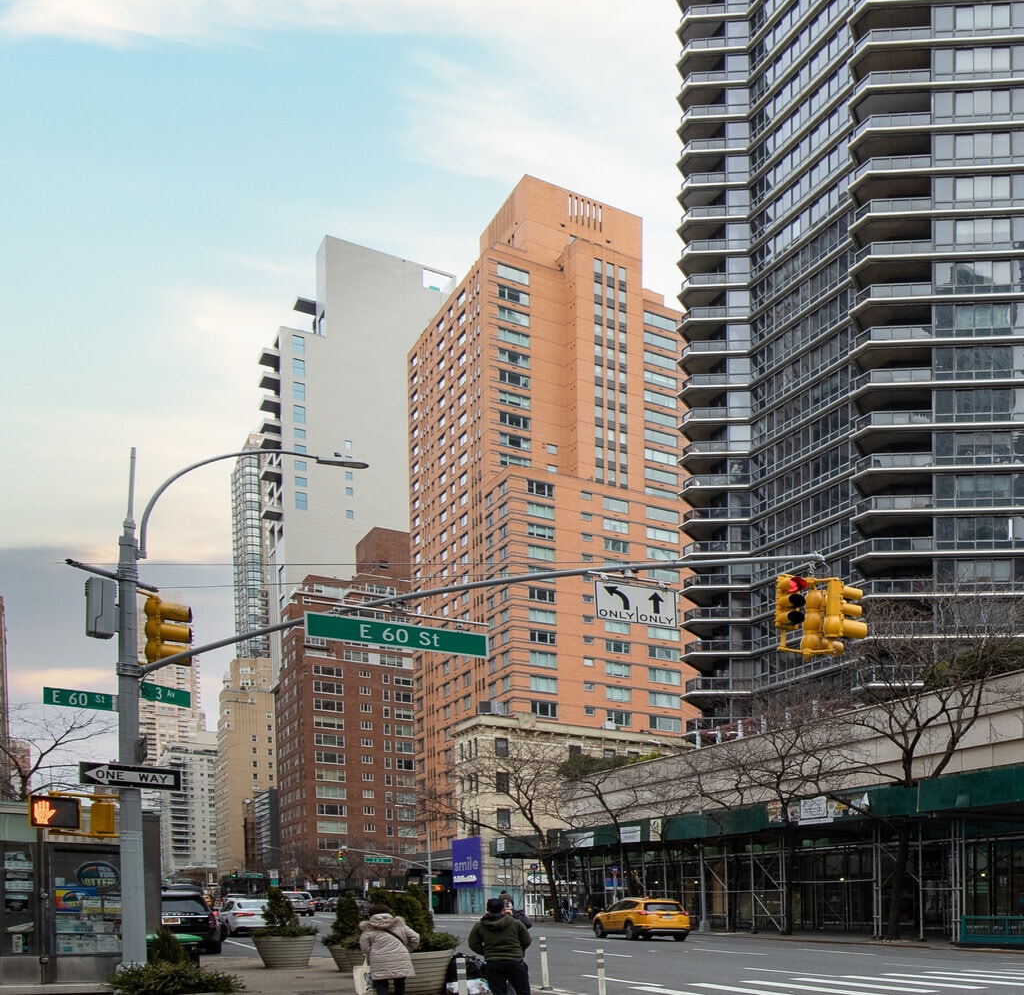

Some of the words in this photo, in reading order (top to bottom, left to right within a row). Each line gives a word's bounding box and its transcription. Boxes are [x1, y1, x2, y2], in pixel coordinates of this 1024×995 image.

[599, 608, 635, 620] ONLY
[640, 614, 674, 624] ONLY
[360, 624, 372, 639] E
[382, 627, 408, 643] 60
[418, 631, 440, 647] St
[52, 690, 61, 704] E
[68, 692, 88, 706] 60
[94, 694, 106, 704] St
[155, 687, 163, 700] 3
[166, 689, 176, 698] Av
[95, 769, 125, 781] ONE
[138, 773, 169, 784] WAY
[454, 856, 479, 872] smile
